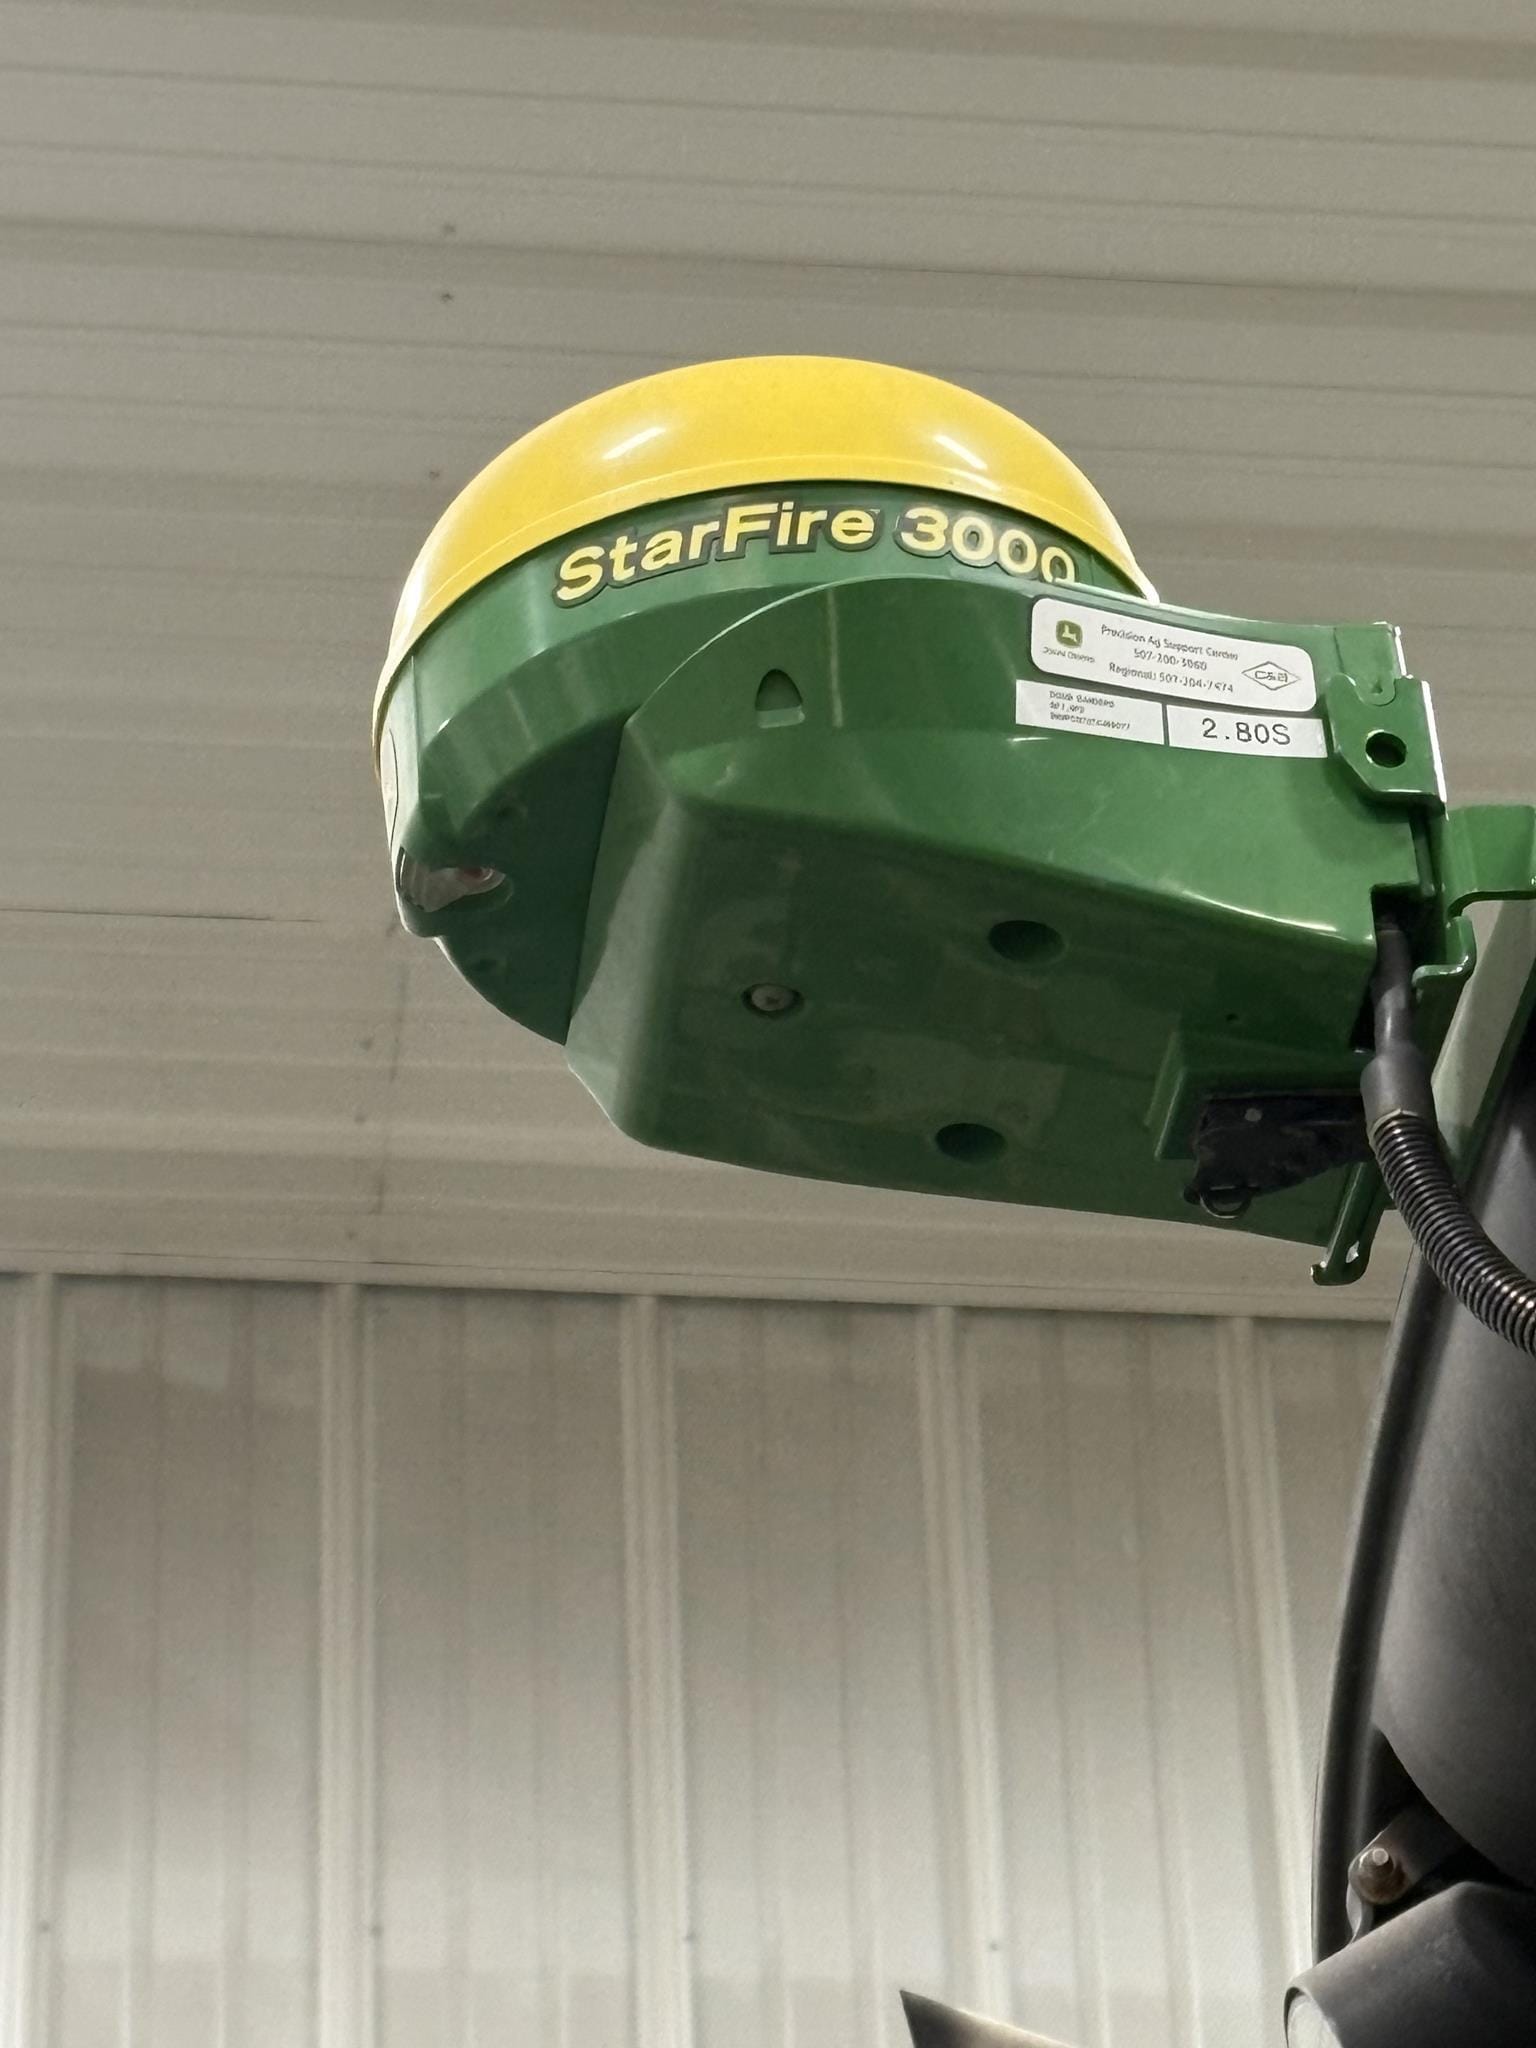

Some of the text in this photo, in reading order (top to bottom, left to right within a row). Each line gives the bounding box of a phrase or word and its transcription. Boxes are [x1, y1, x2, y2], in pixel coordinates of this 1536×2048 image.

[556, 500, 1077, 603] StarFire 3000
[1164, 638, 1203, 655] Support
